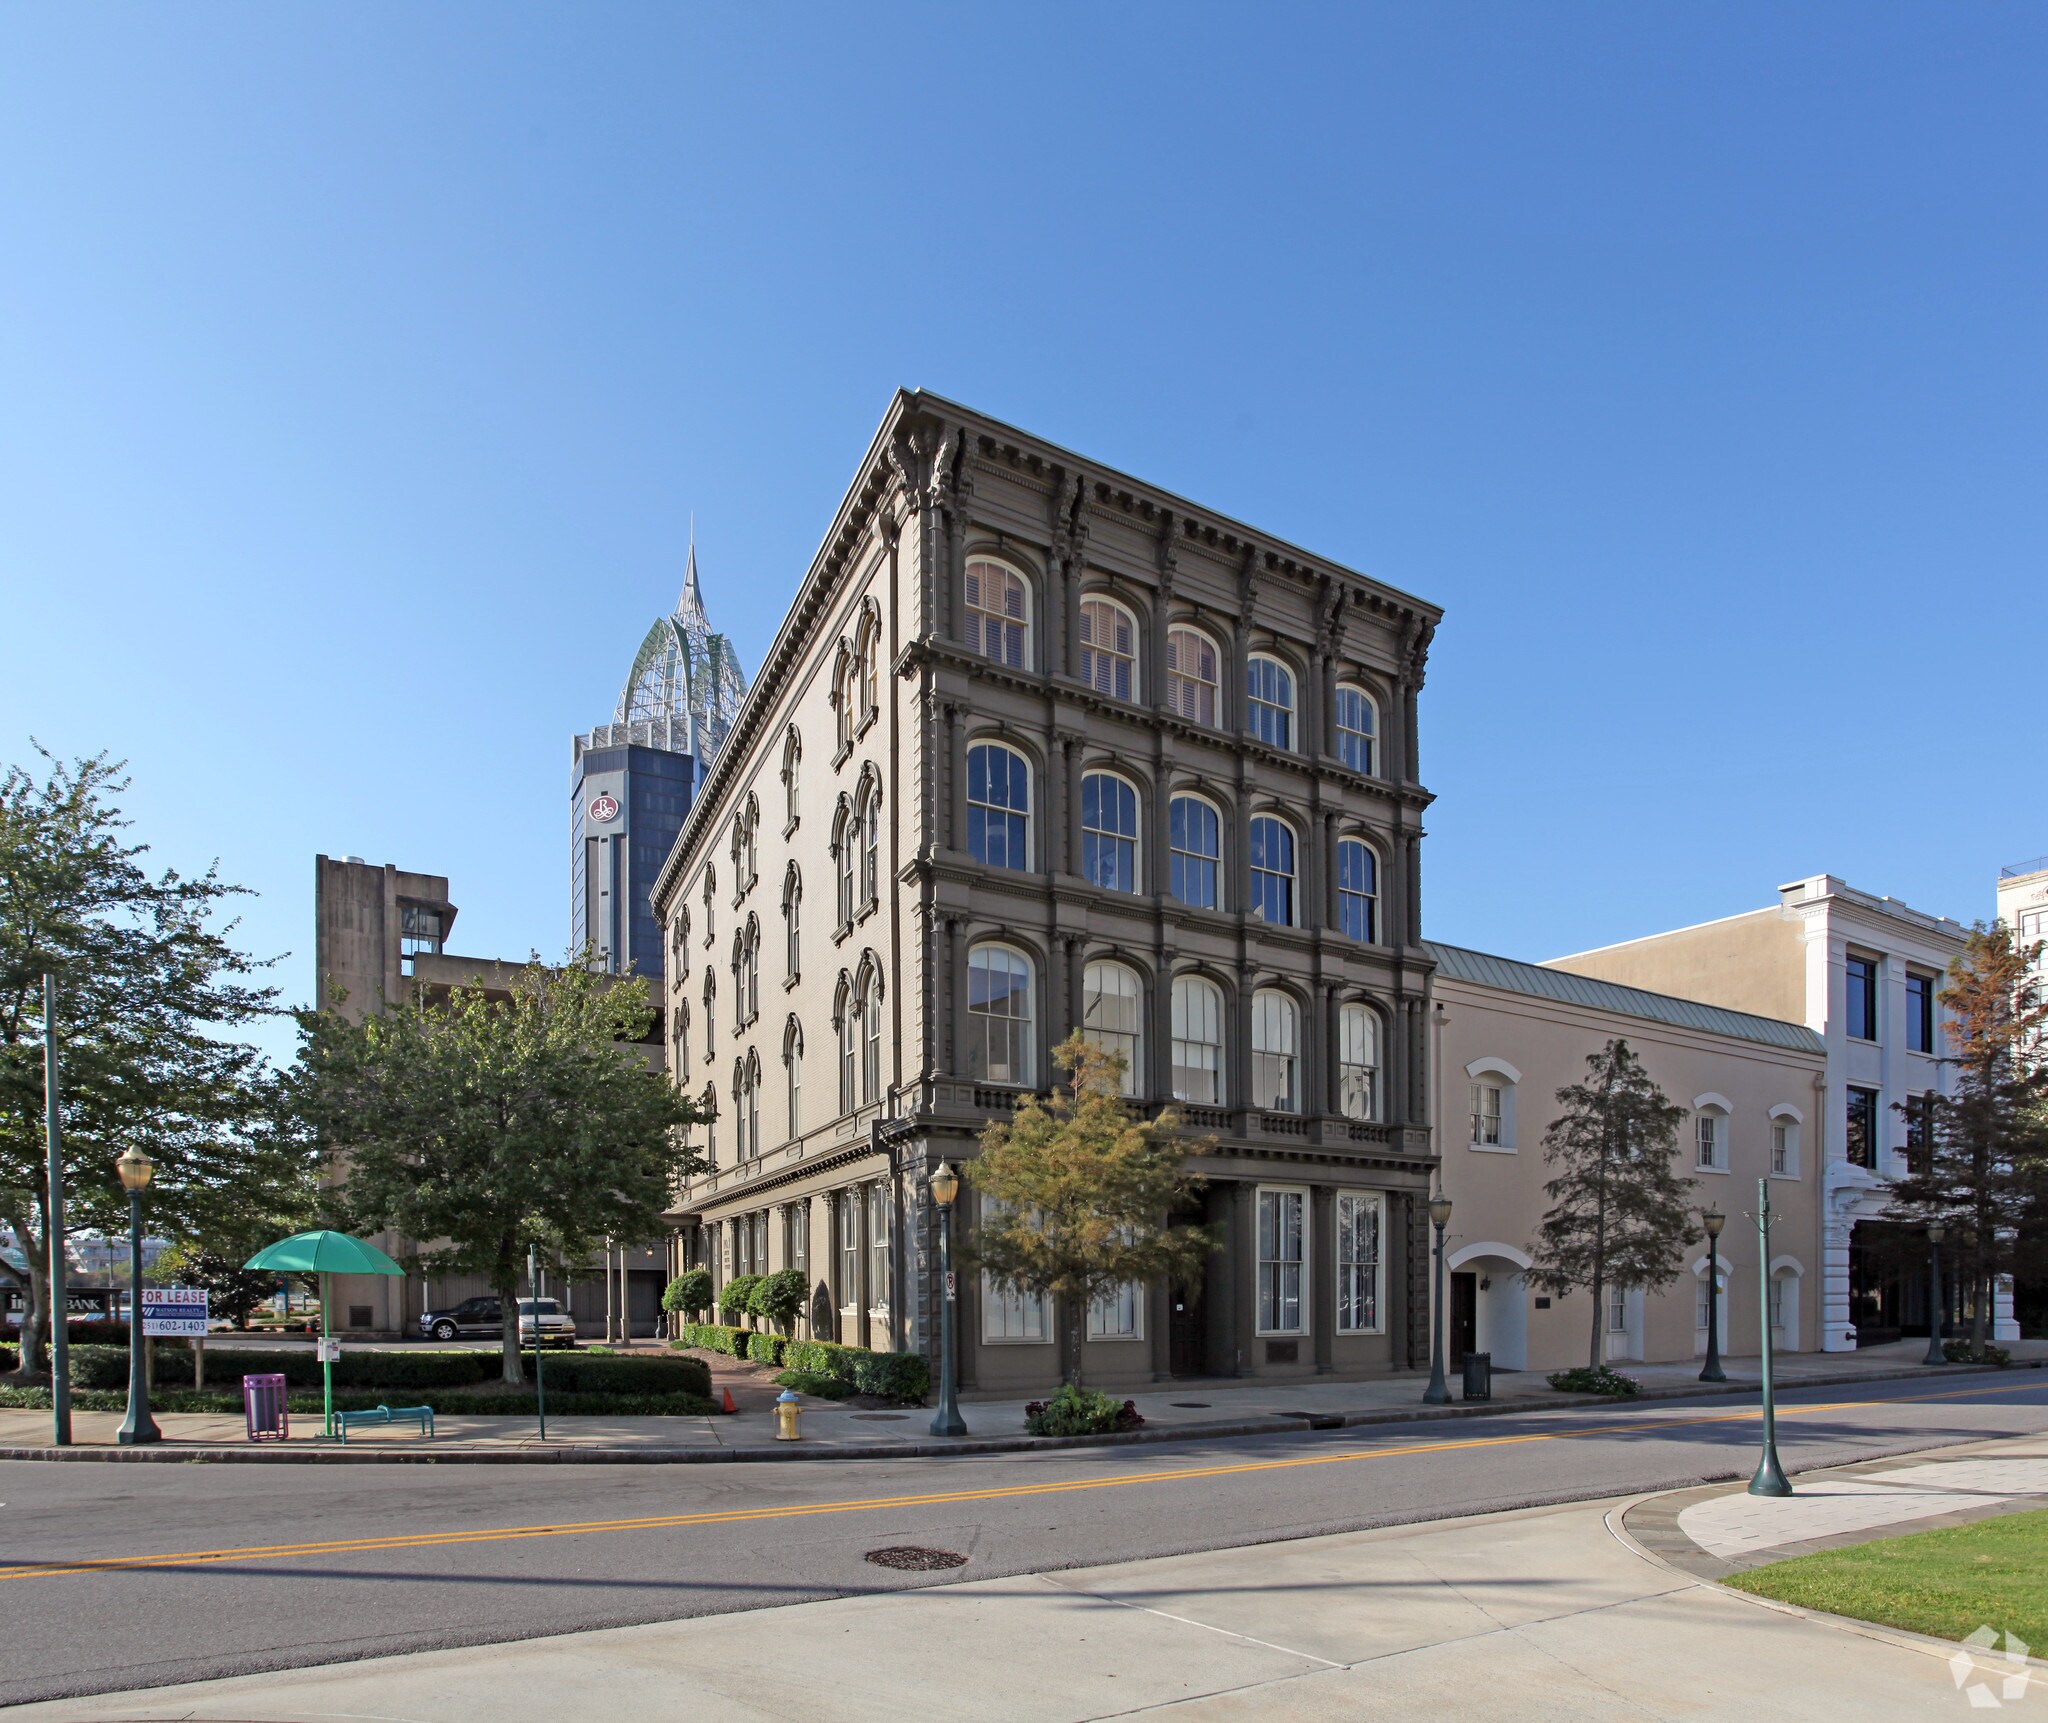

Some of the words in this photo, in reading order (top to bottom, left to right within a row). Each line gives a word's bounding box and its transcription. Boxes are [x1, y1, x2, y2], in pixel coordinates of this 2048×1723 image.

[140, 1291, 163, 1303] FOR
[167, 1291, 205, 1303] LEASE
[143, 1322, 158, 1330] 251)
[159, 1320, 205, 1331] 602-1403
